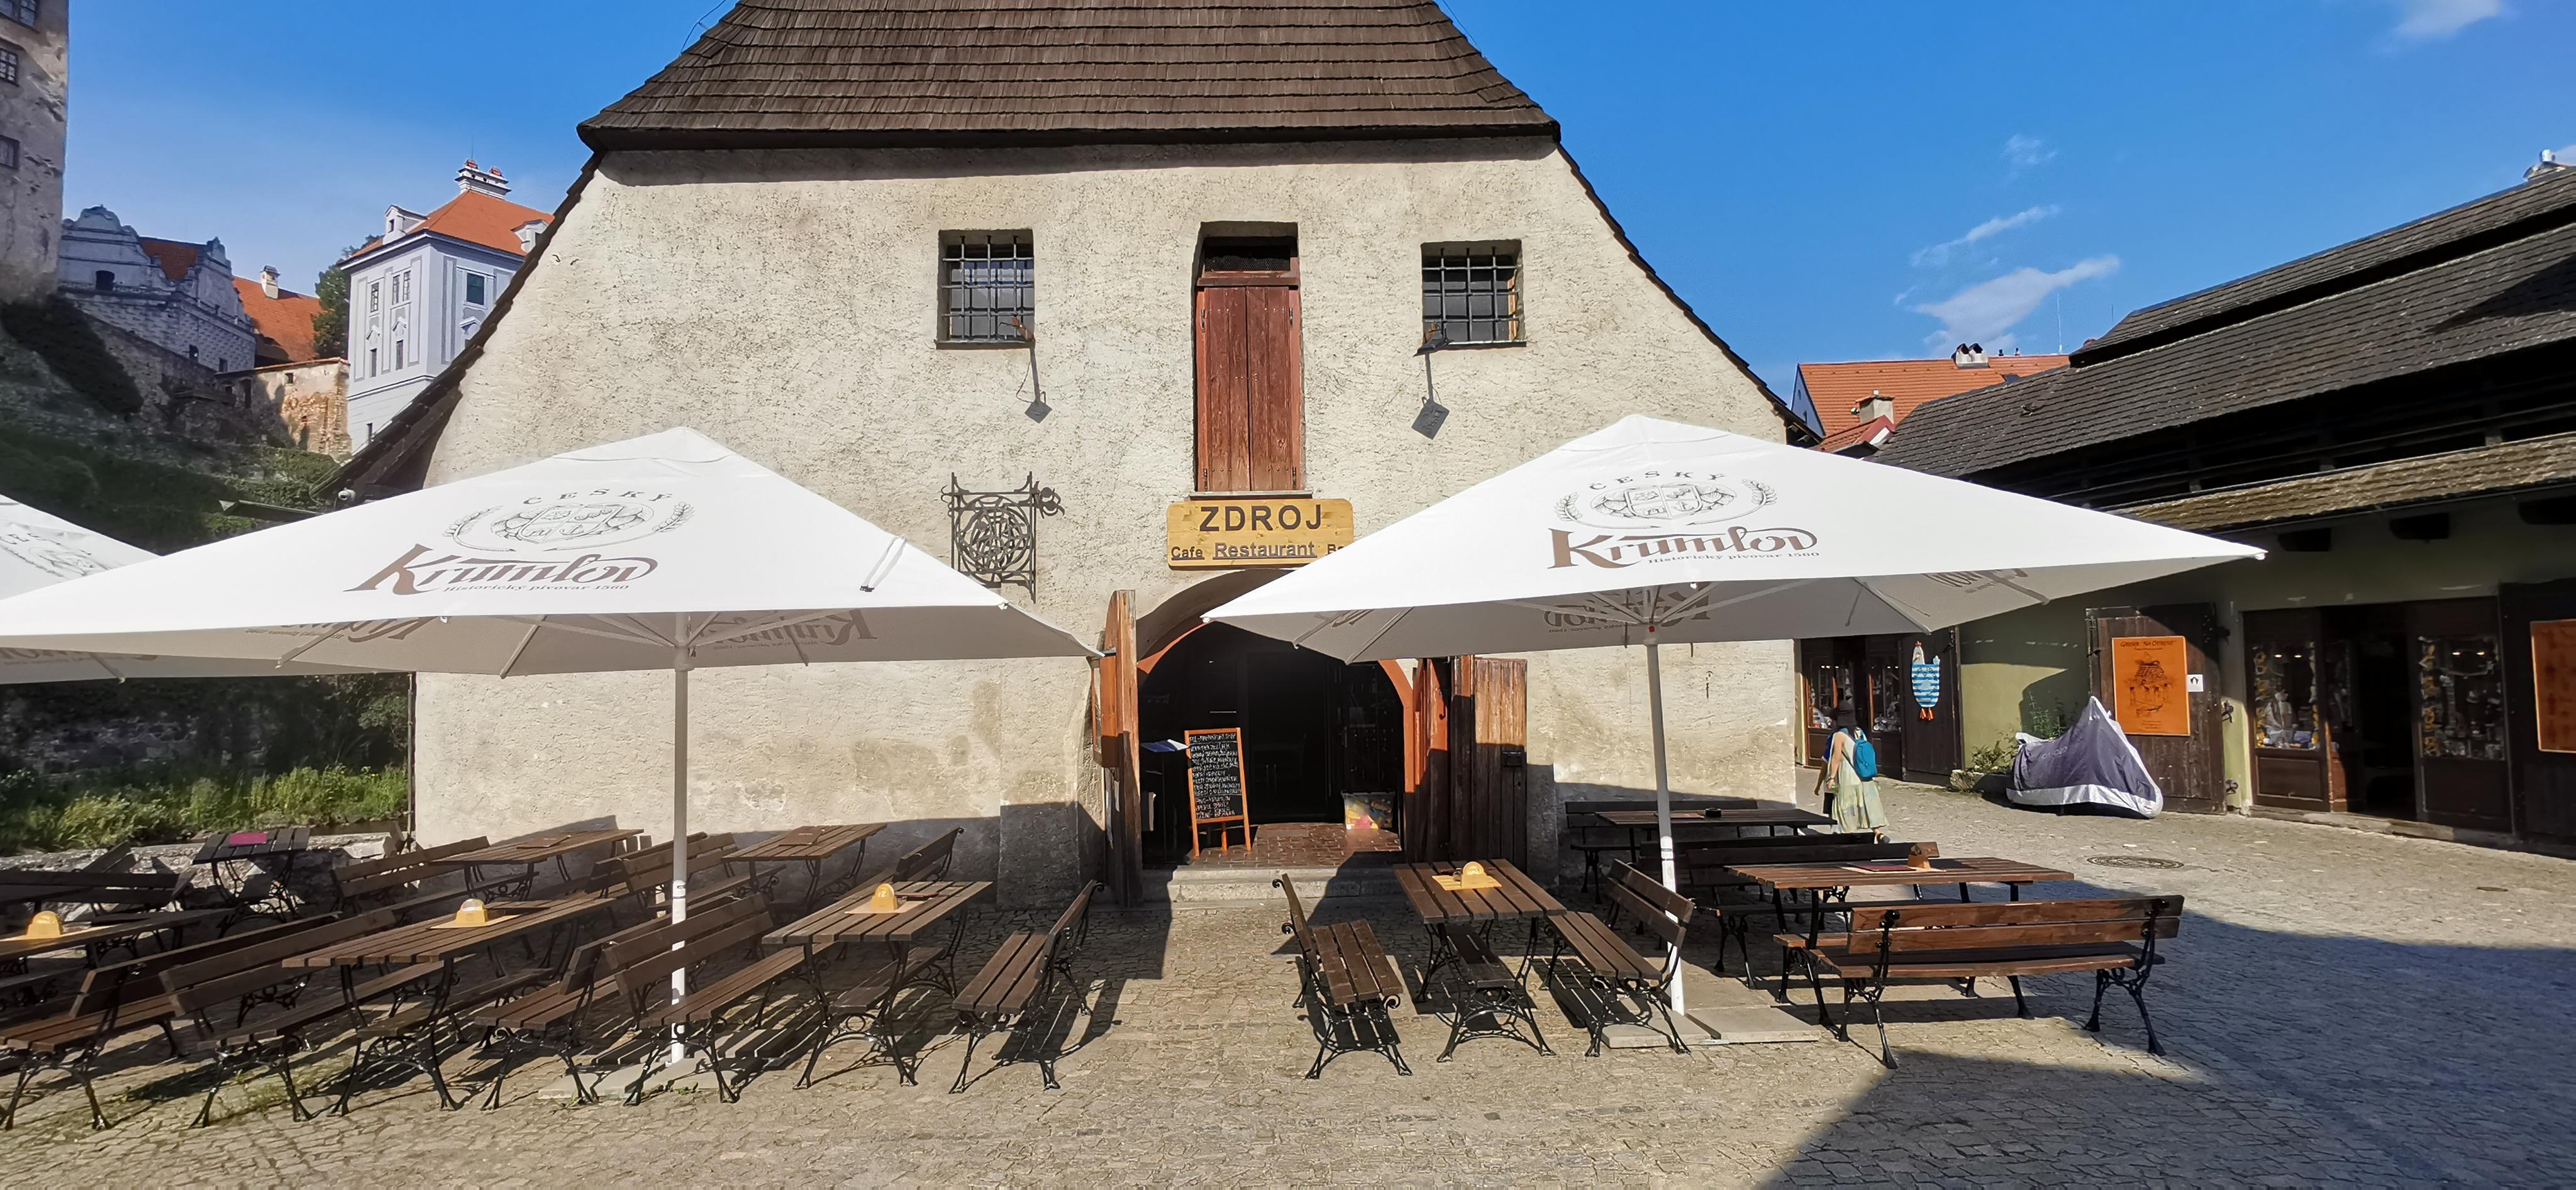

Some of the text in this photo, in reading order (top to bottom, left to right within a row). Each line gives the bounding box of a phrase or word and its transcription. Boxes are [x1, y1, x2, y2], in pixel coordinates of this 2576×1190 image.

[1199, 504, 1321, 532] ZDROJ
[1171, 542, 1345, 559] Cafe Restaurant B
[1547, 526, 1818, 569] Krumlov
[1728, 552, 1782, 561] pivovar
[342, 543, 658, 596] Krumlov
